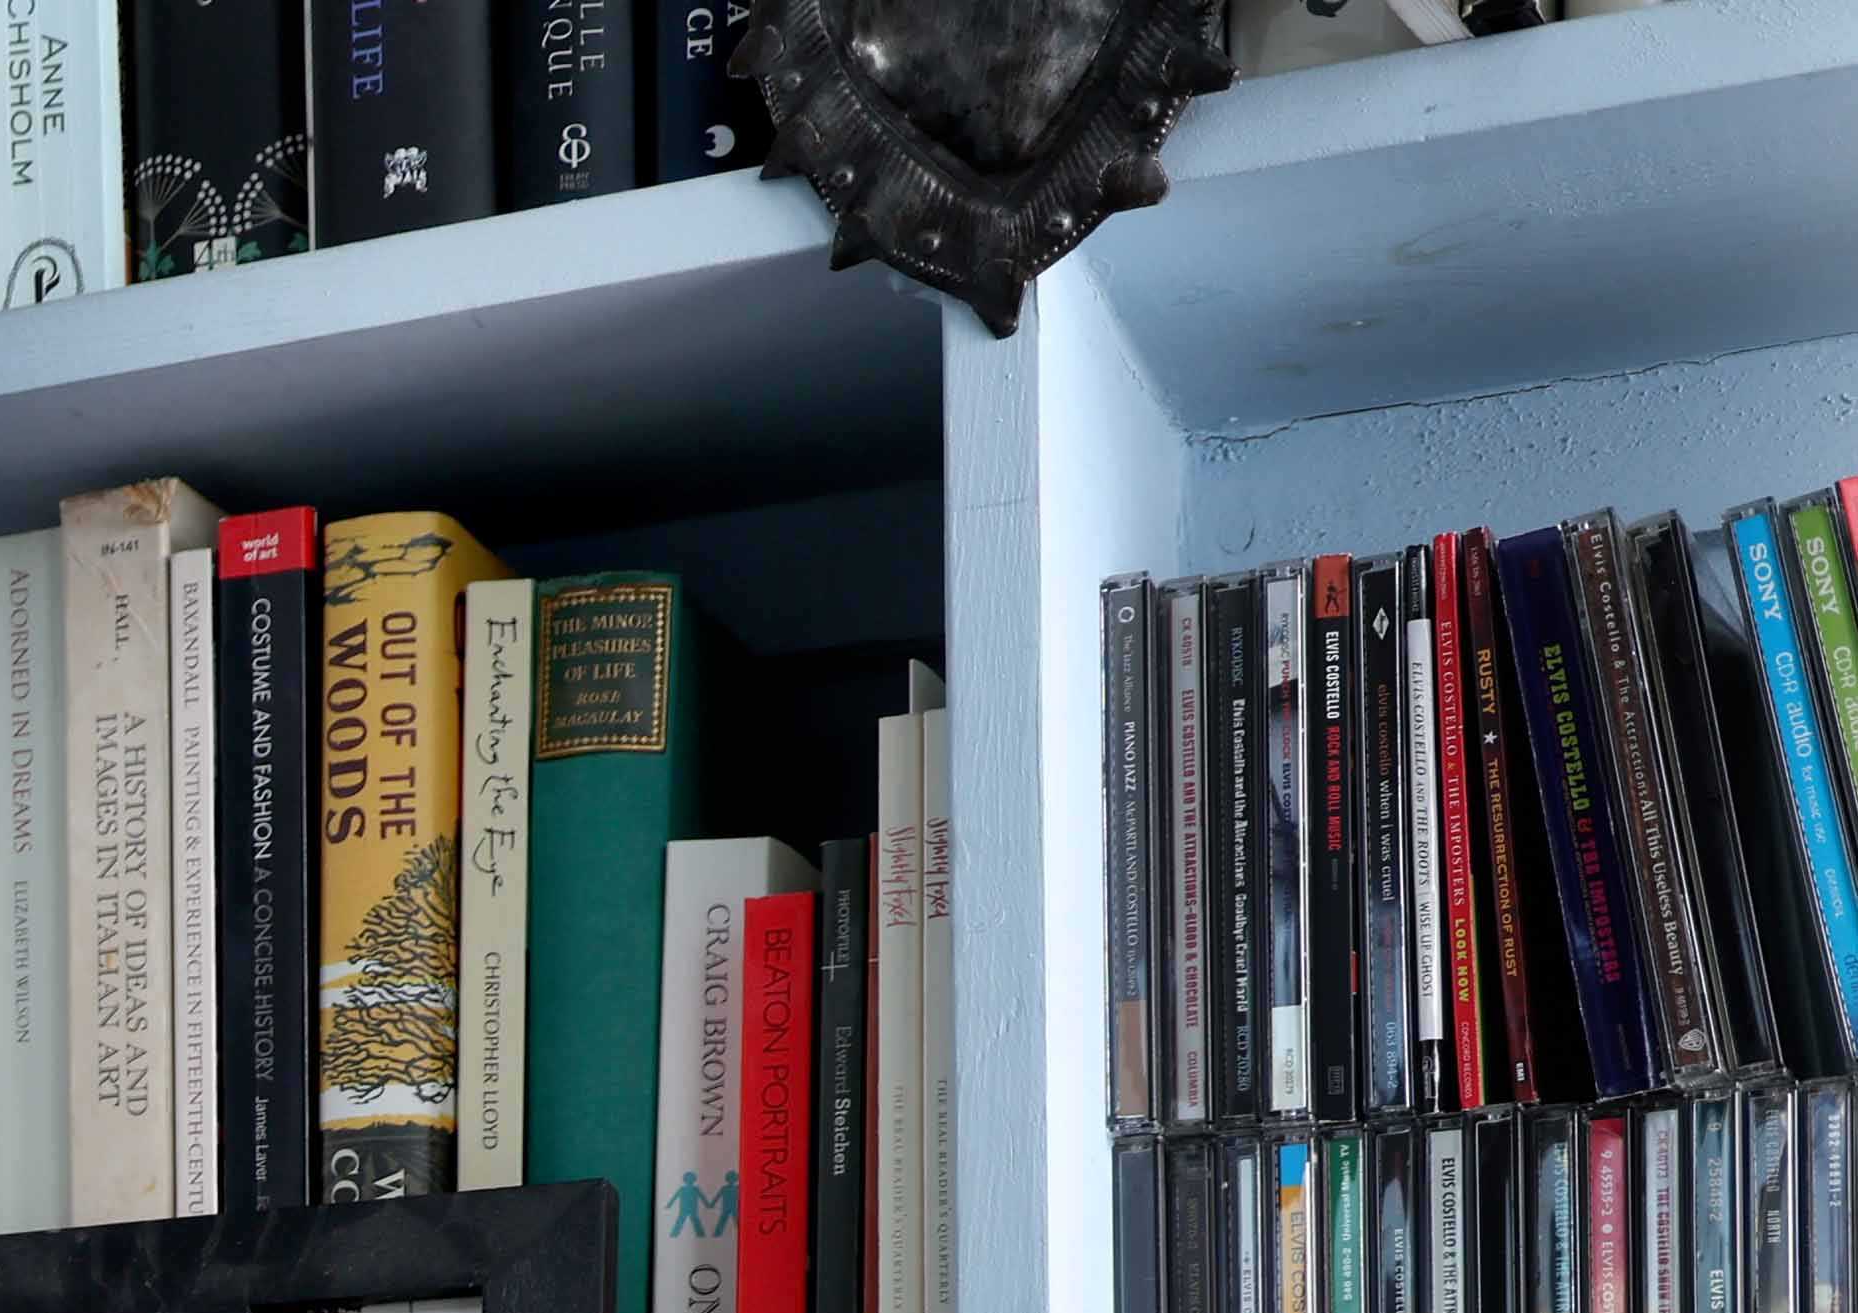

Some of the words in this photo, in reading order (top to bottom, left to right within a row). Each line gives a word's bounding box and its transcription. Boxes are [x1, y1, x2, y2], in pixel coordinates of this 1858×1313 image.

[41, 34, 66, 136] ANNE
[1748, 542, 1783, 621] SONY
[1805, 537, 1839, 614] SONY
[252, 597, 271, 702] COSTUME
[380, 611, 416, 686] OUT
[476, 617, 518, 764] Enchanting
[253, 708, 272, 758] AND
[325, 618, 366, 844] WOODS
[381, 709, 416, 747] OF
[253, 762, 272, 859] FASHION
[381, 768, 415, 841] THE
[479, 774, 518, 818] the
[472, 828, 515, 897] Eye
[706, 903, 731, 1007] CRAIG
[762, 927, 793, 1055] BEATON
[482, 950, 502, 1084] CHRISTOPHER
[481, 1089, 500, 1151] LLOYD
[700, 1017, 728, 1137] BROWN
[758, 1062, 791, 1237] PORTRAITS
[1708, 1268, 1725, 1309] ELVIS
